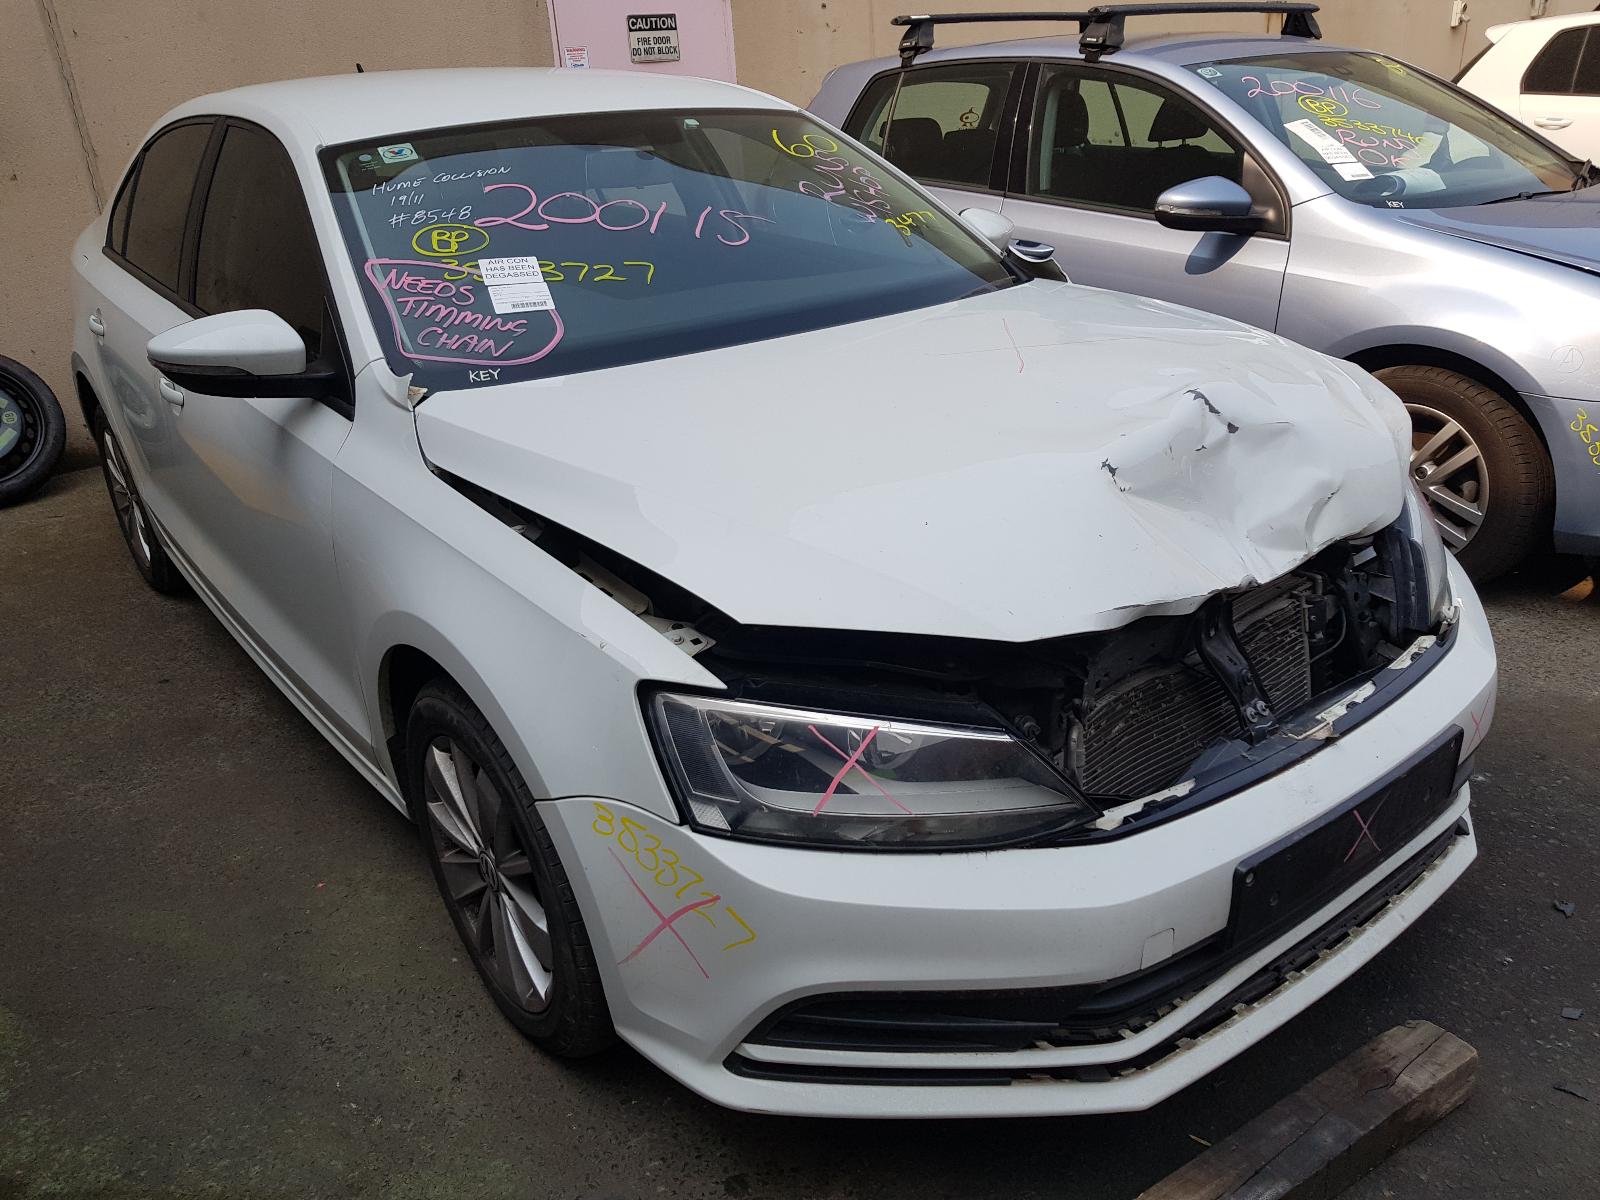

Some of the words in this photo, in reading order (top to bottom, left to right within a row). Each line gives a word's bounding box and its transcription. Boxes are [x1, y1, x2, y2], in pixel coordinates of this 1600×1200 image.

[629, 17, 676, 29] CAUTION
[637, 37, 651, 46] FIRE
[653, 36, 671, 45] DOOR
[632, 48, 642, 56] DO
[644, 47, 655, 55] NOT
[657, 46, 678, 54] BLOCK
[1241, 76, 1382, 110] 200116
[772, 129, 838, 157] 60
[372, 177, 427, 195] HUME
[388, 205, 473, 228] #8548
[485, 271, 540, 279] DEGASSED
[382, 268, 477, 306] NEEDS
[417, 326, 515, 358] CHAIN
[468, 368, 502, 383] KEY
